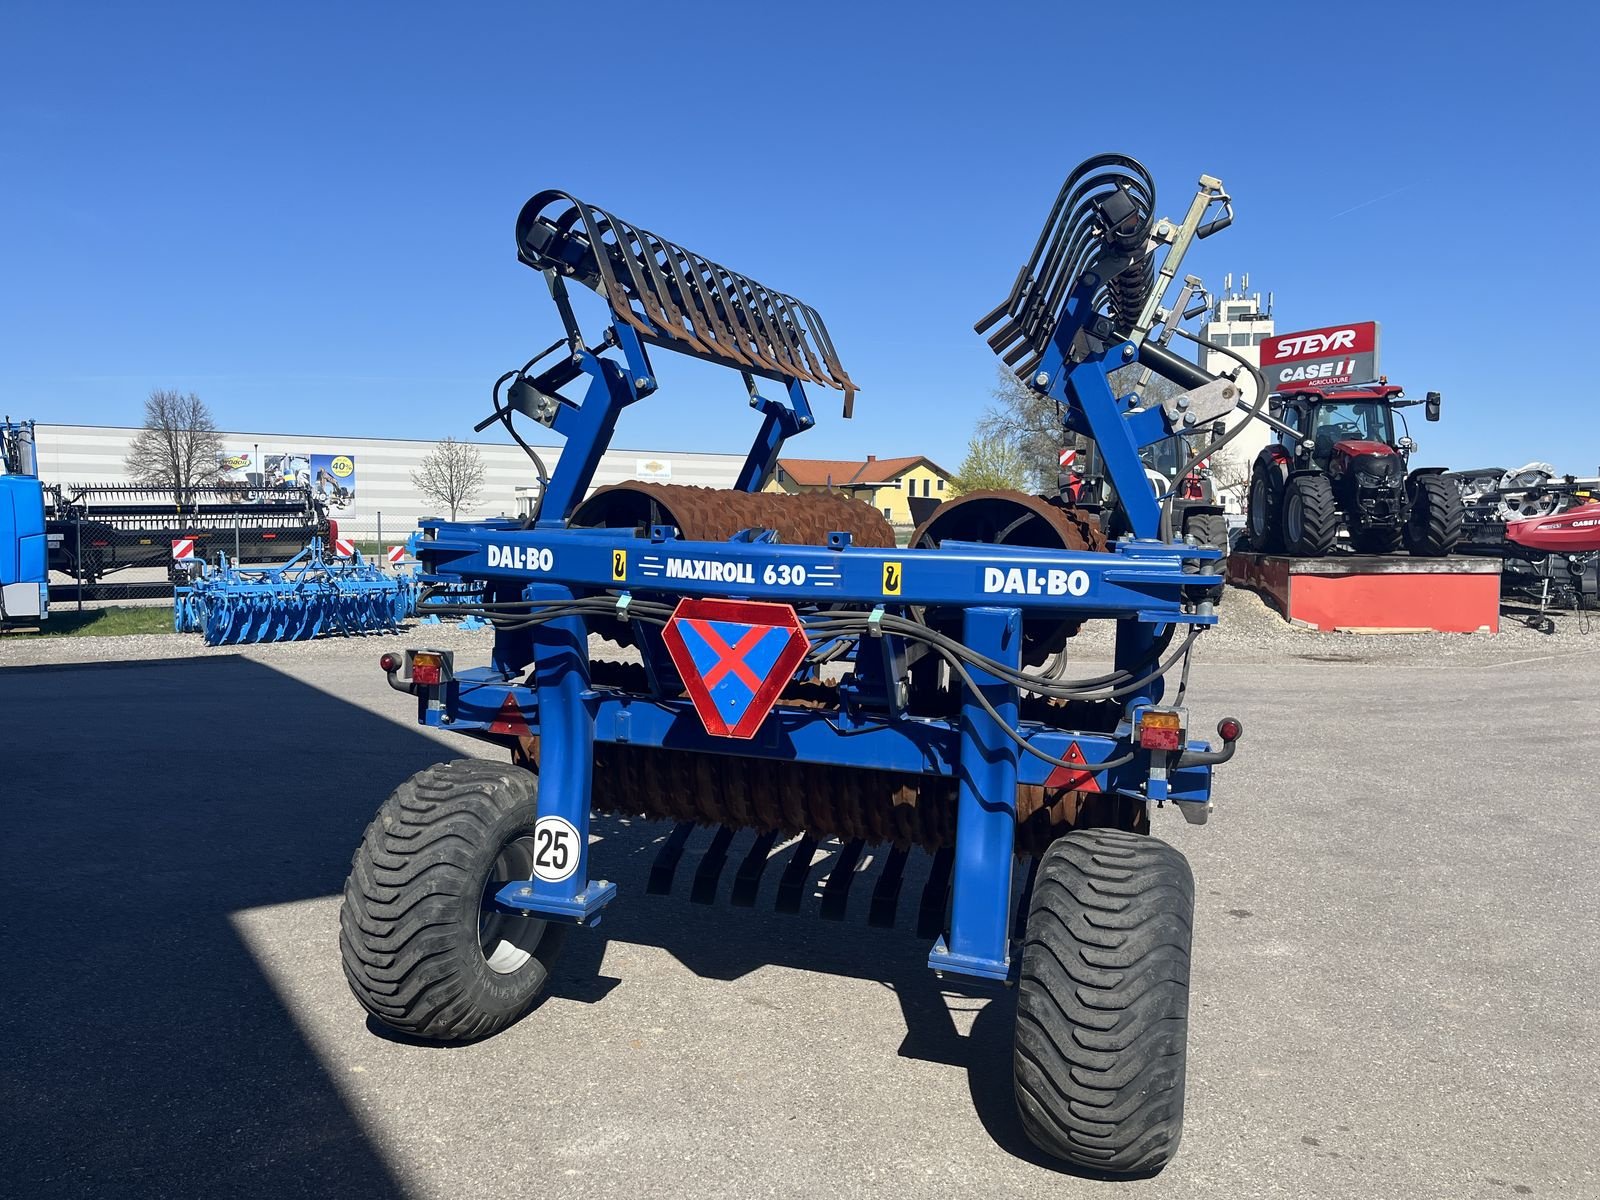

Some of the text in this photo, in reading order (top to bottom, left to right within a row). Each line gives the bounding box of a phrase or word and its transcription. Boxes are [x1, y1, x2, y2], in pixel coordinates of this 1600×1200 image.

[1275, 330, 1356, 358] STEYR
[1280, 363, 1333, 382] CASE
[1308, 377, 1348, 386] AGRICULTURE
[332, 462, 352, 471] 40%
[1572, 519, 1594, 527] CASE
[666, 558, 806, 586] MAXIROLL 630
[536, 829, 568, 870] 25
